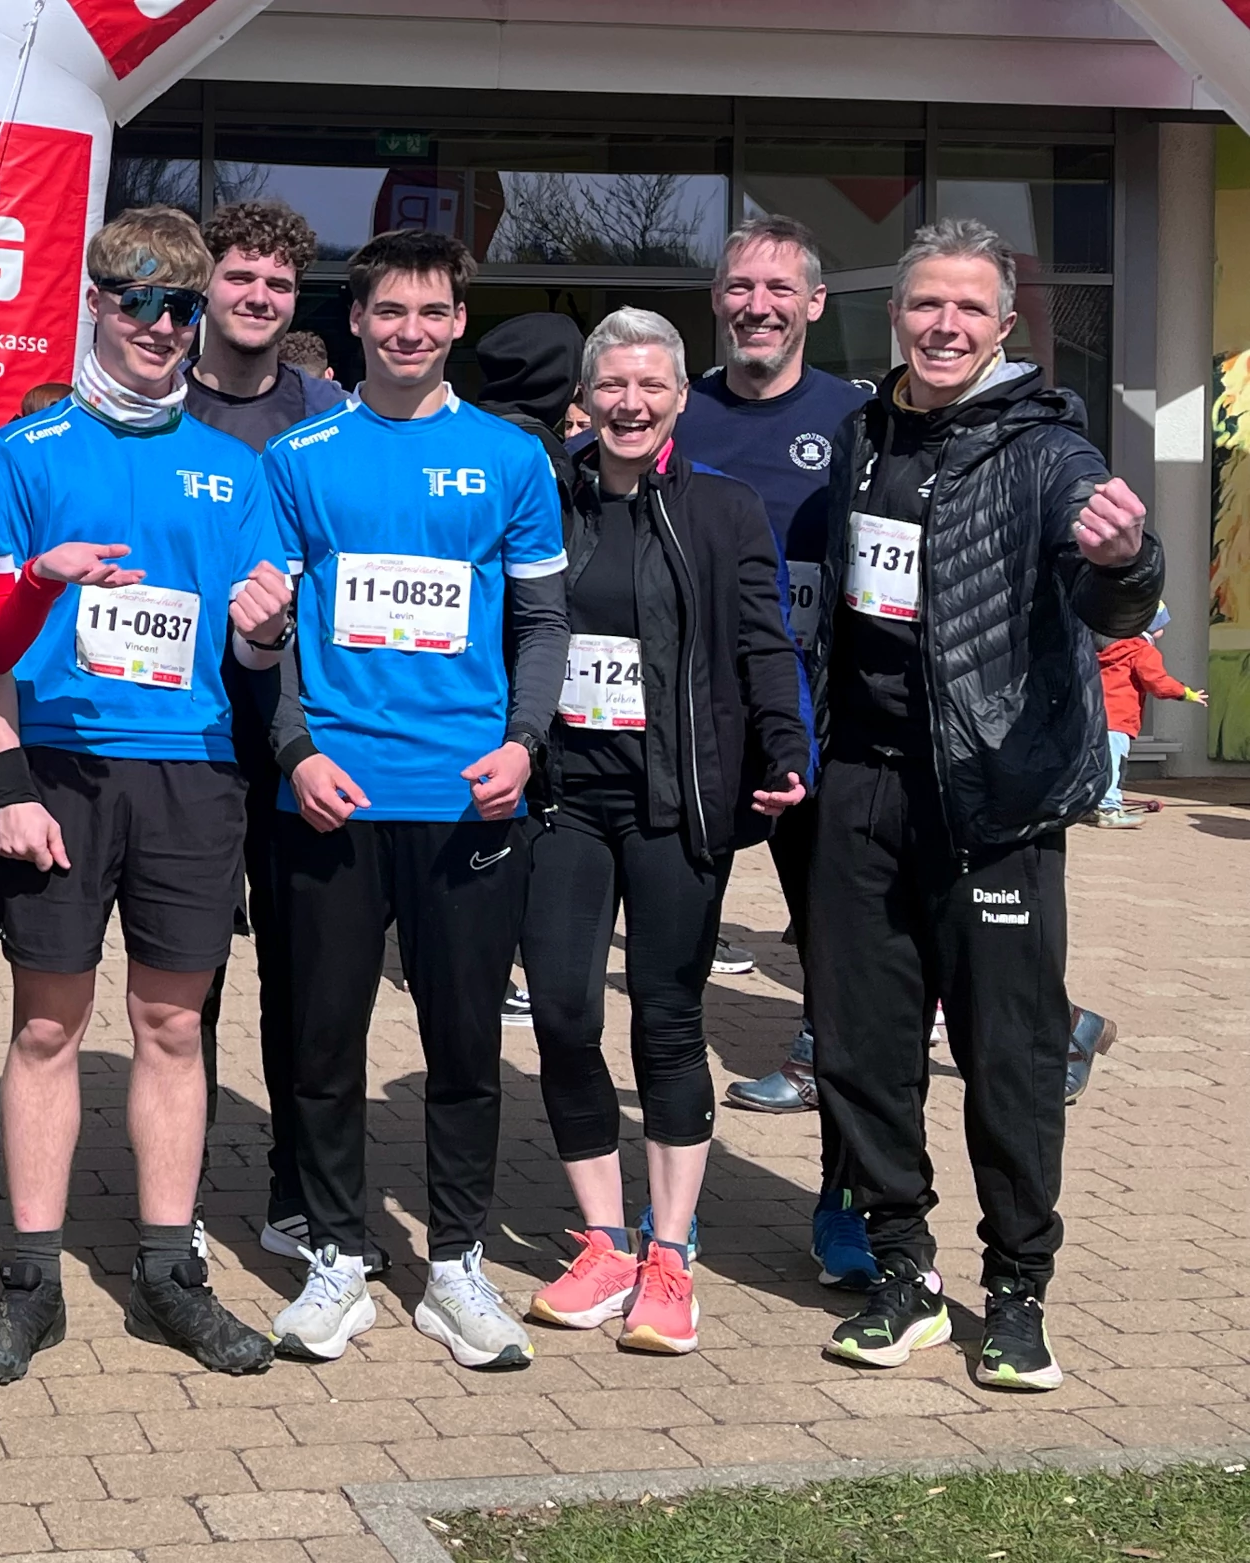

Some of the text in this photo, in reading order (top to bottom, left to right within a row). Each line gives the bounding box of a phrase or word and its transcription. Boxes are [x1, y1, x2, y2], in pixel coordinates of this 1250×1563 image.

[24, 420, 71, 444] Kempa
[289, 426, 340, 450] Kempa
[176, 470, 233, 502] THG
[422, 468, 486, 496] THG
[346, 577, 461, 608] 11-0832
[88, 604, 192, 642] 11-0837
[389, 611, 414, 620] Levin
[125, 641, 159, 654] Vincent
[564, 659, 641, 686] 1-124
[973, 888, 1021, 904] Daniel
[982, 910, 1030, 924] hummel
